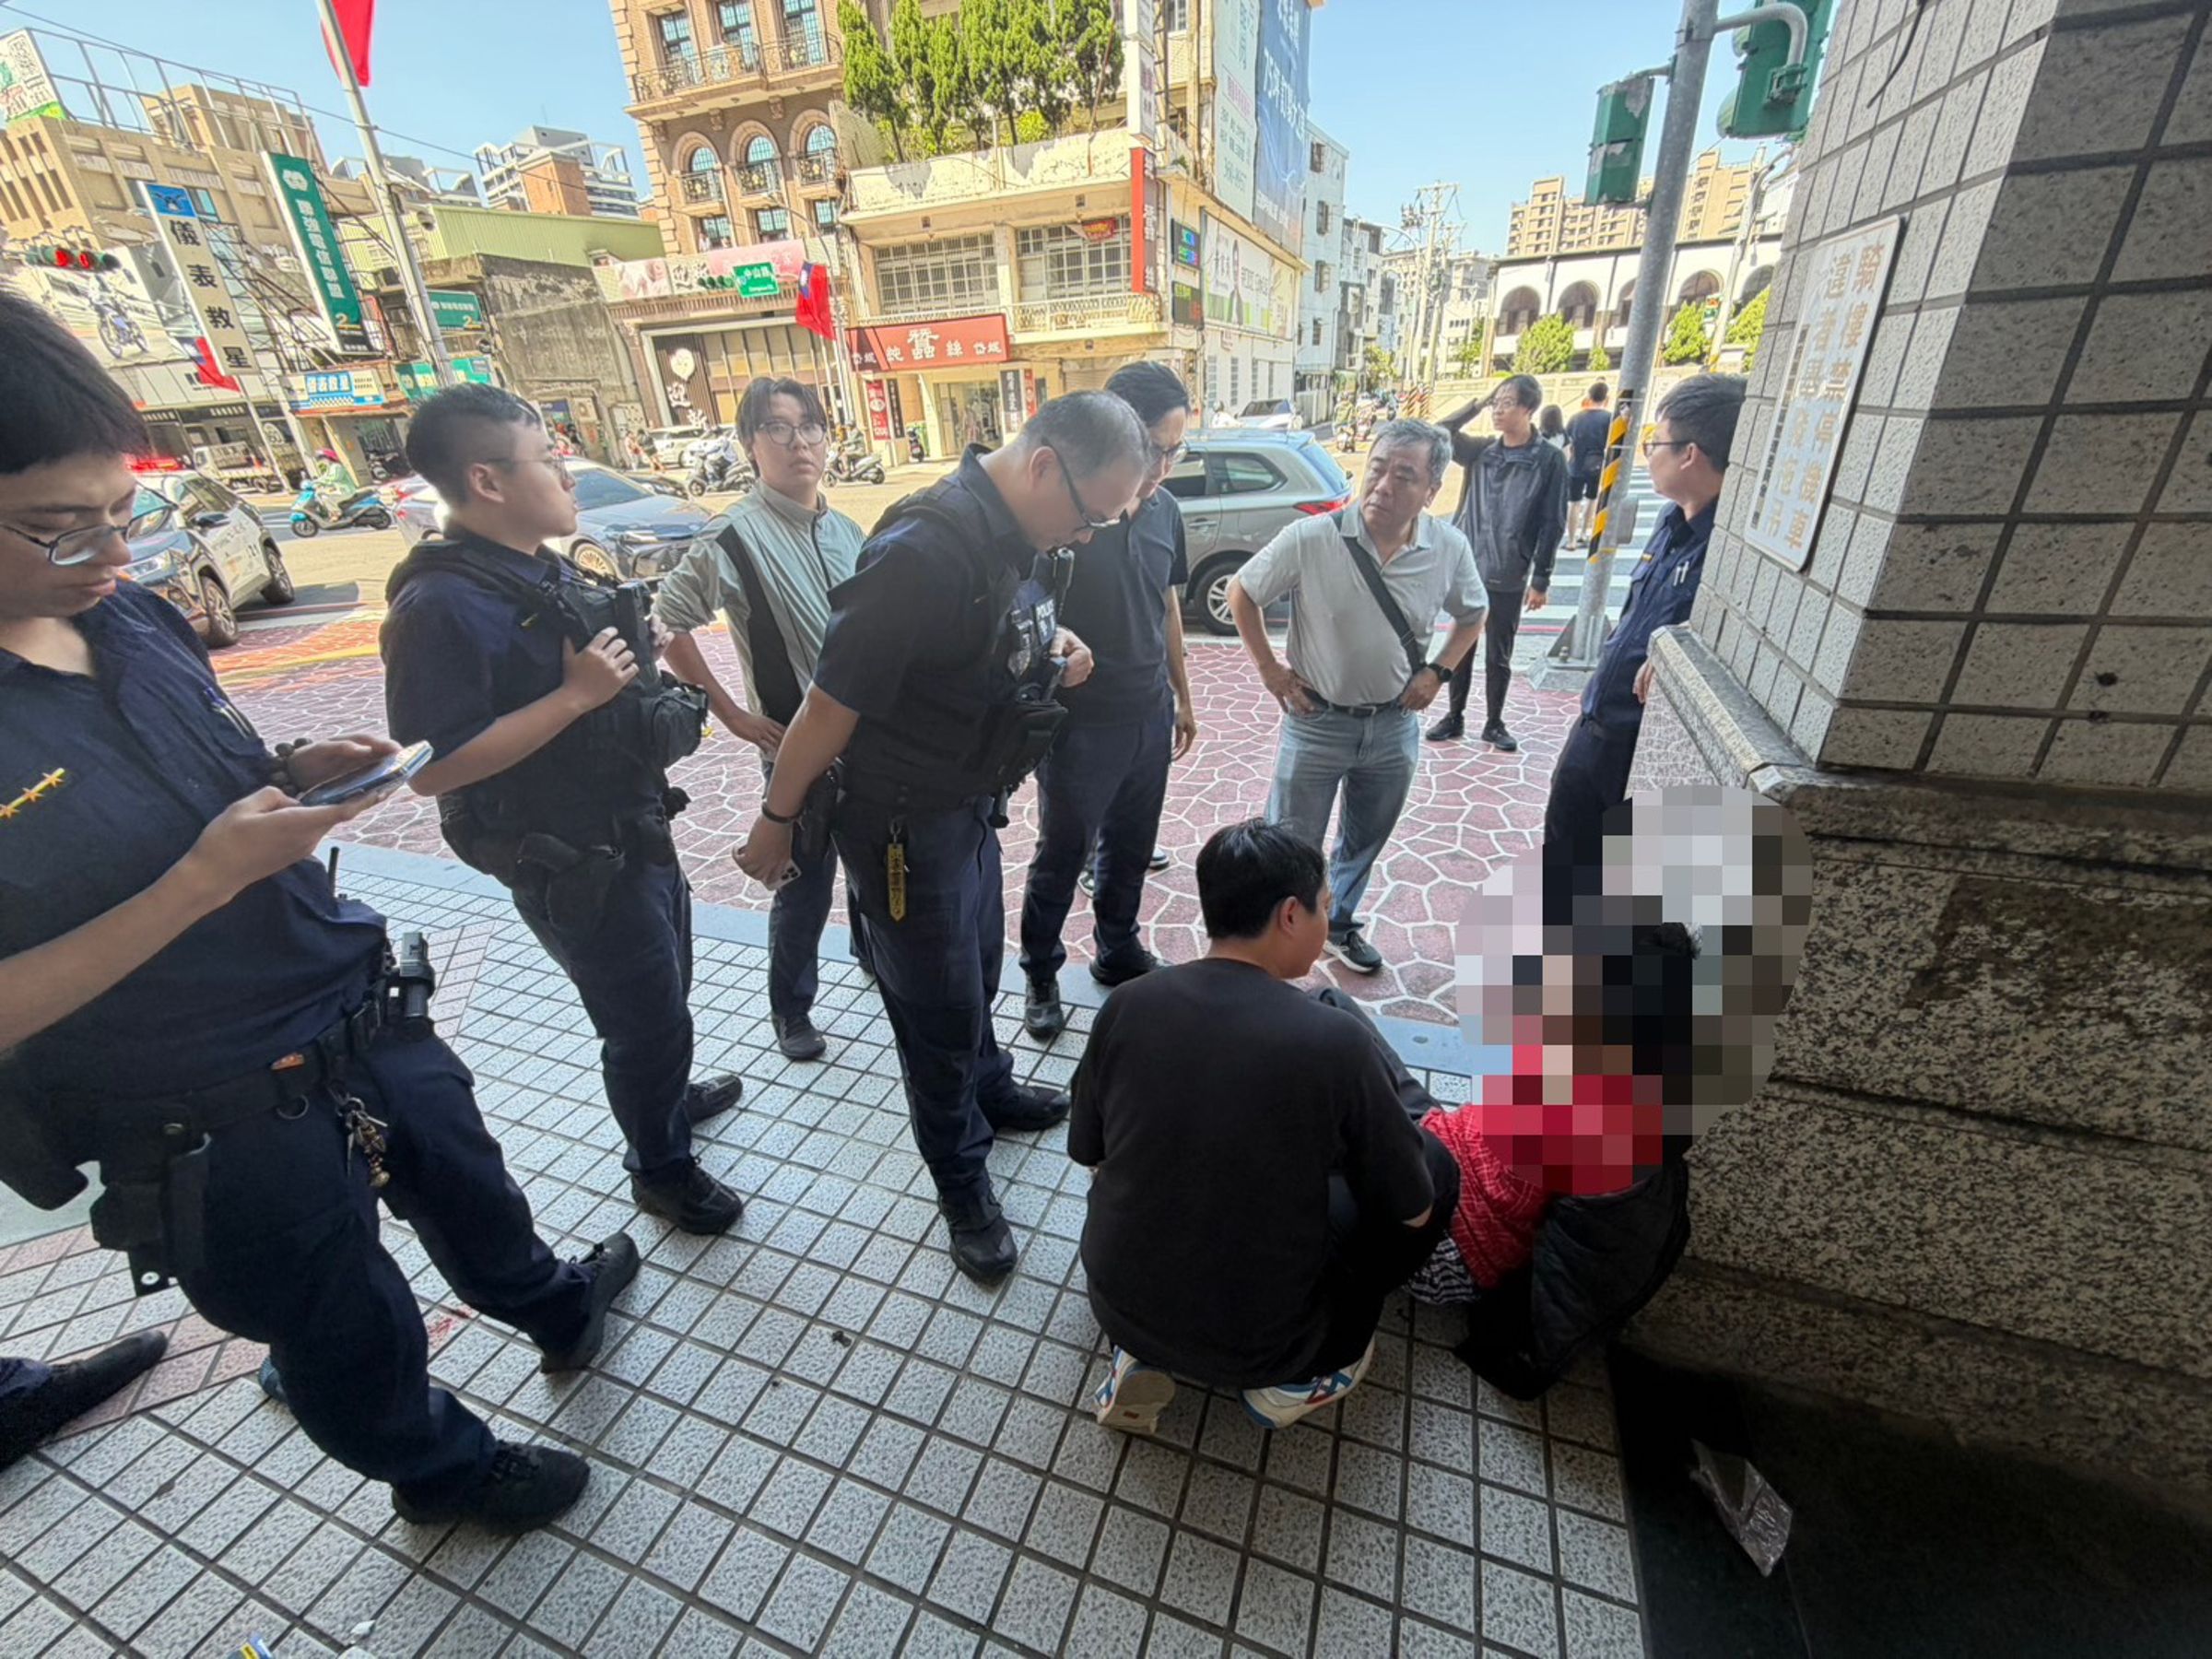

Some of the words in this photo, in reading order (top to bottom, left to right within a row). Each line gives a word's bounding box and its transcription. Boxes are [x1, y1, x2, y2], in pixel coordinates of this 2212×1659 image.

[170, 219, 253, 369] 儀表救星
[1783, 243, 1886, 550] 騎樓禁停機車
